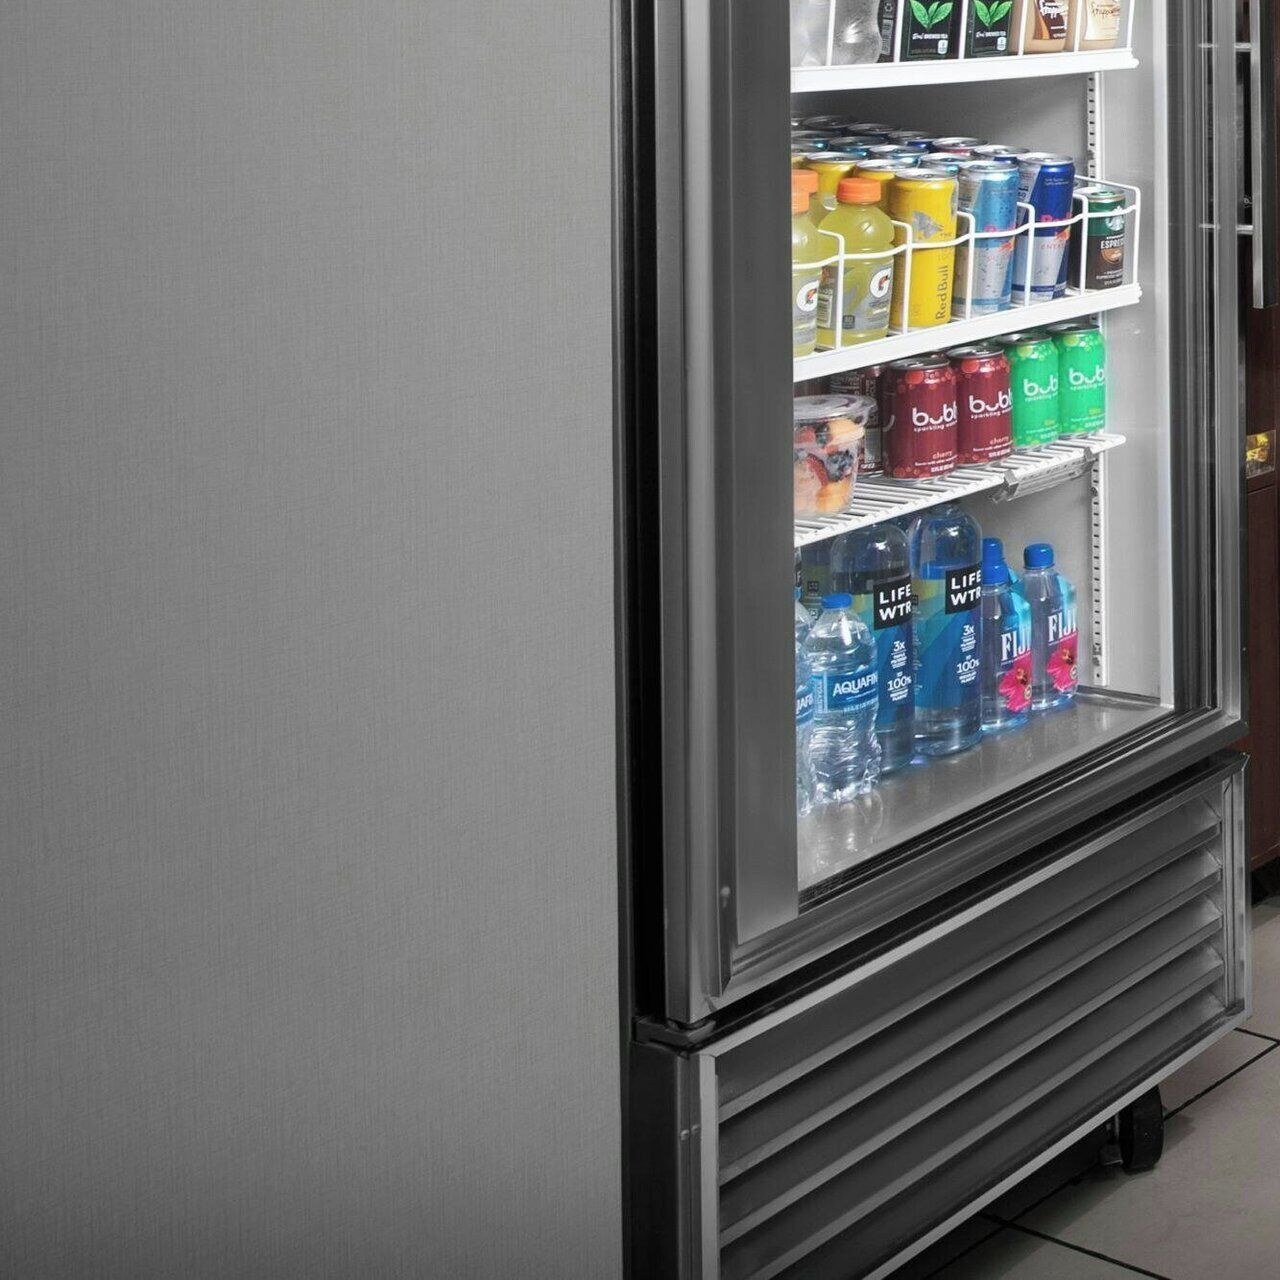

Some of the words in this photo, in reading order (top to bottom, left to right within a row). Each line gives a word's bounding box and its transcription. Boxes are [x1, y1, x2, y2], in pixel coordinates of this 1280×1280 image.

[951, 568, 981, 589] LIFE
[880, 584, 911, 604] LIFE
[879, 602, 912, 620] WTR
